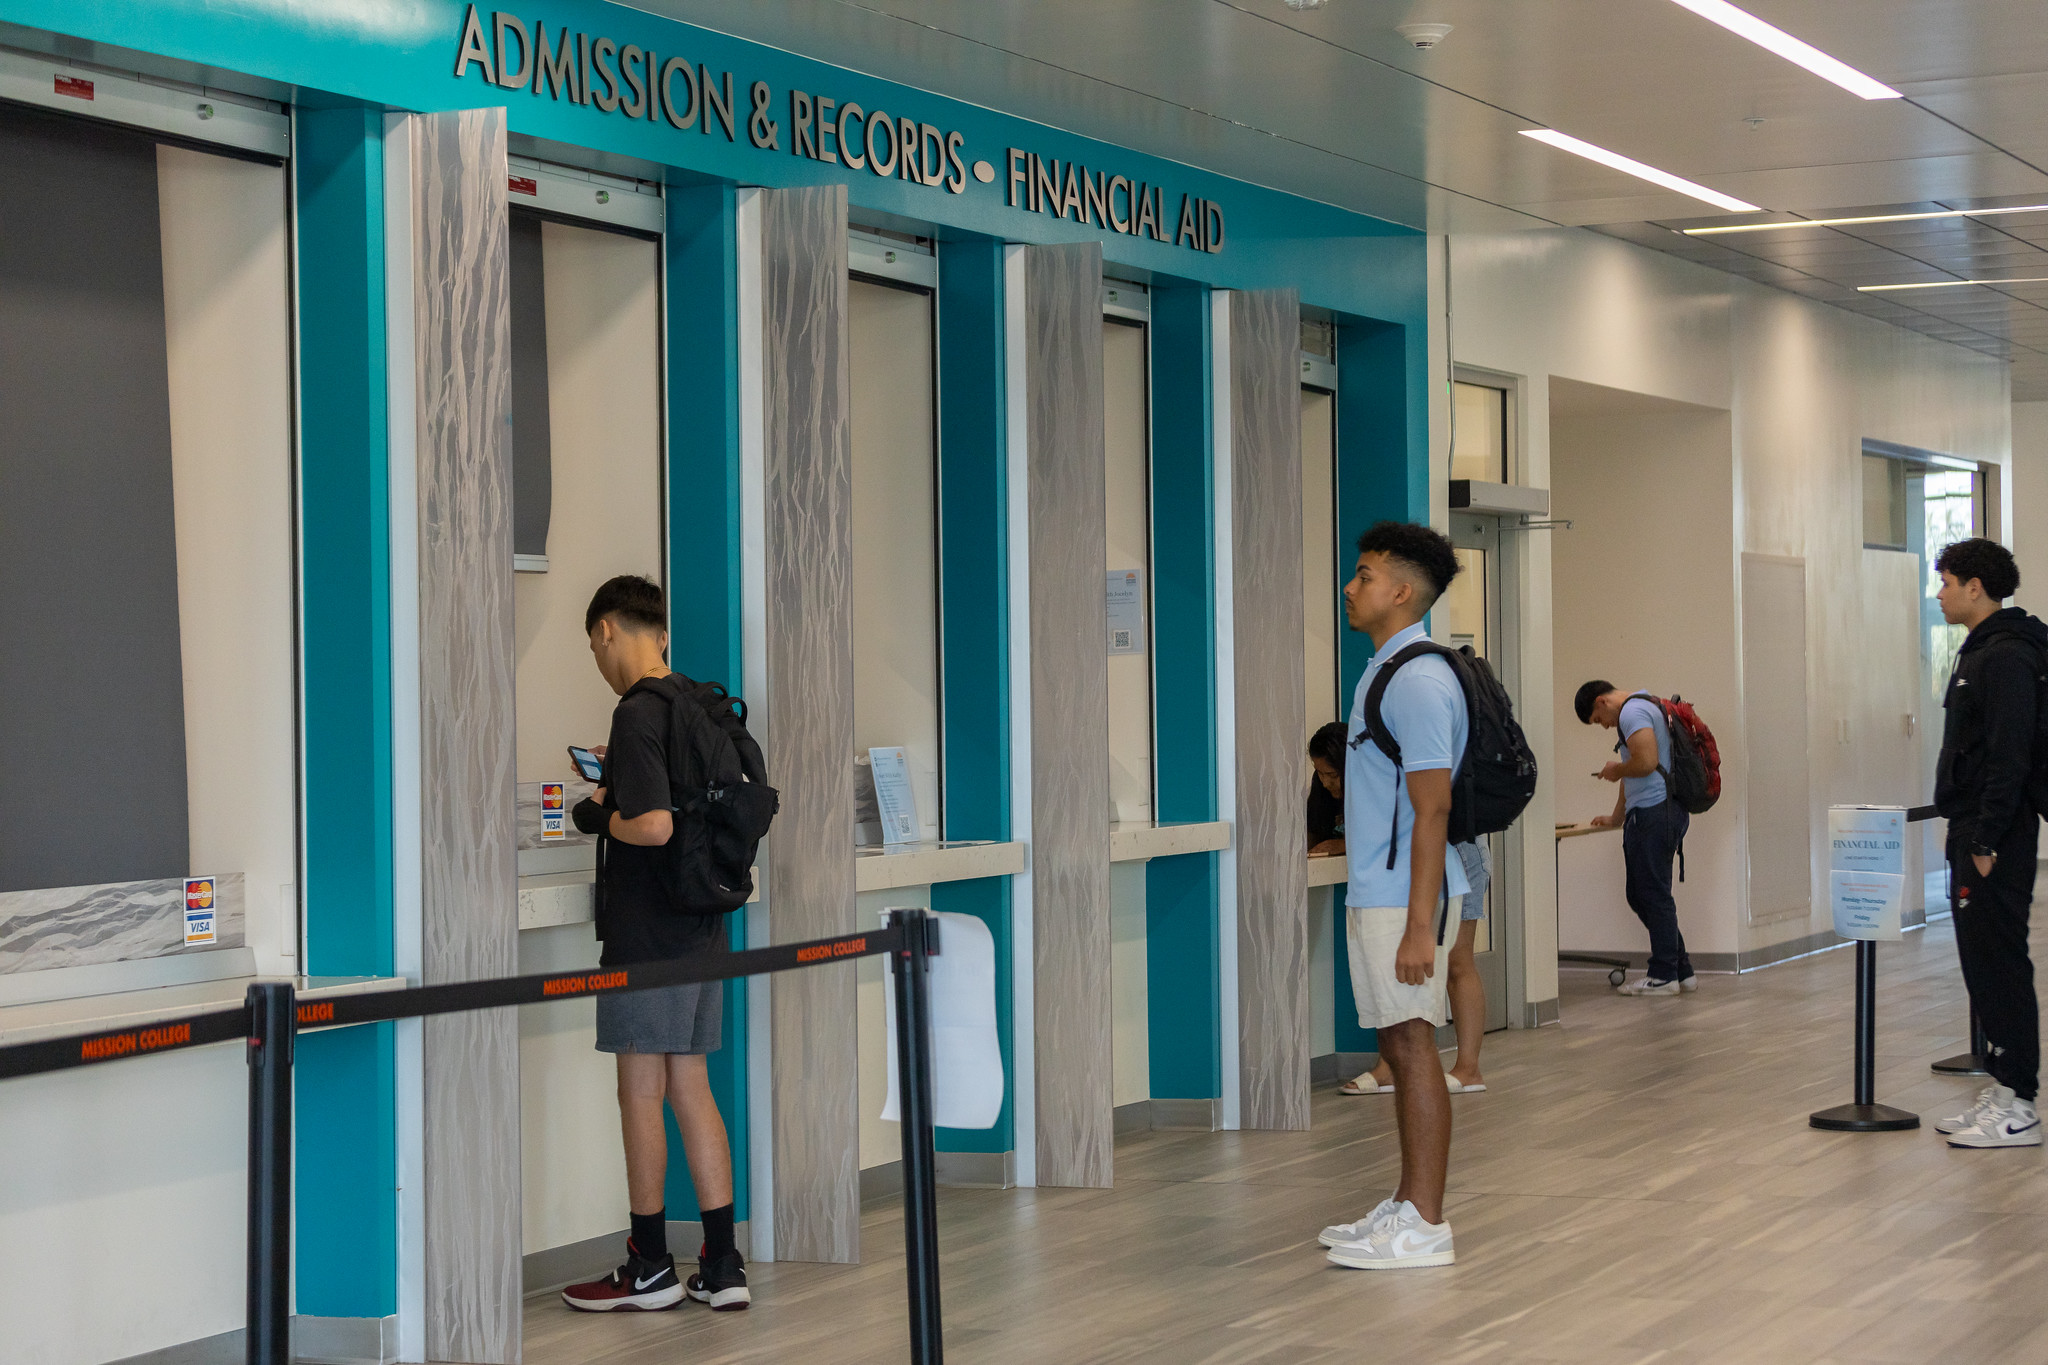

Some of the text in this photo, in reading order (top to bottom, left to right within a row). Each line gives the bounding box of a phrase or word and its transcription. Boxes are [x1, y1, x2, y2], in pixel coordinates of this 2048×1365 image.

[454, 2, 735, 142] ADMISSION
[749, 80, 780, 151] &
[789, 88, 967, 195] RECORDS
[1006, 147, 1170, 244] FINANCIAL
[1177, 192, 1226, 254] AID
[546, 820, 561, 830] VISA
[1833, 839, 1900, 850] FINANCIAL AID
[191, 921, 209, 933] VISA
[797, 937, 866, 963] MISSION COLLEGE
[543, 970, 628, 996] MISSION COLLEGE
[297, 1002, 334, 1023] LLEGE
[81, 1022, 191, 1060] MISSION COLLEGE
